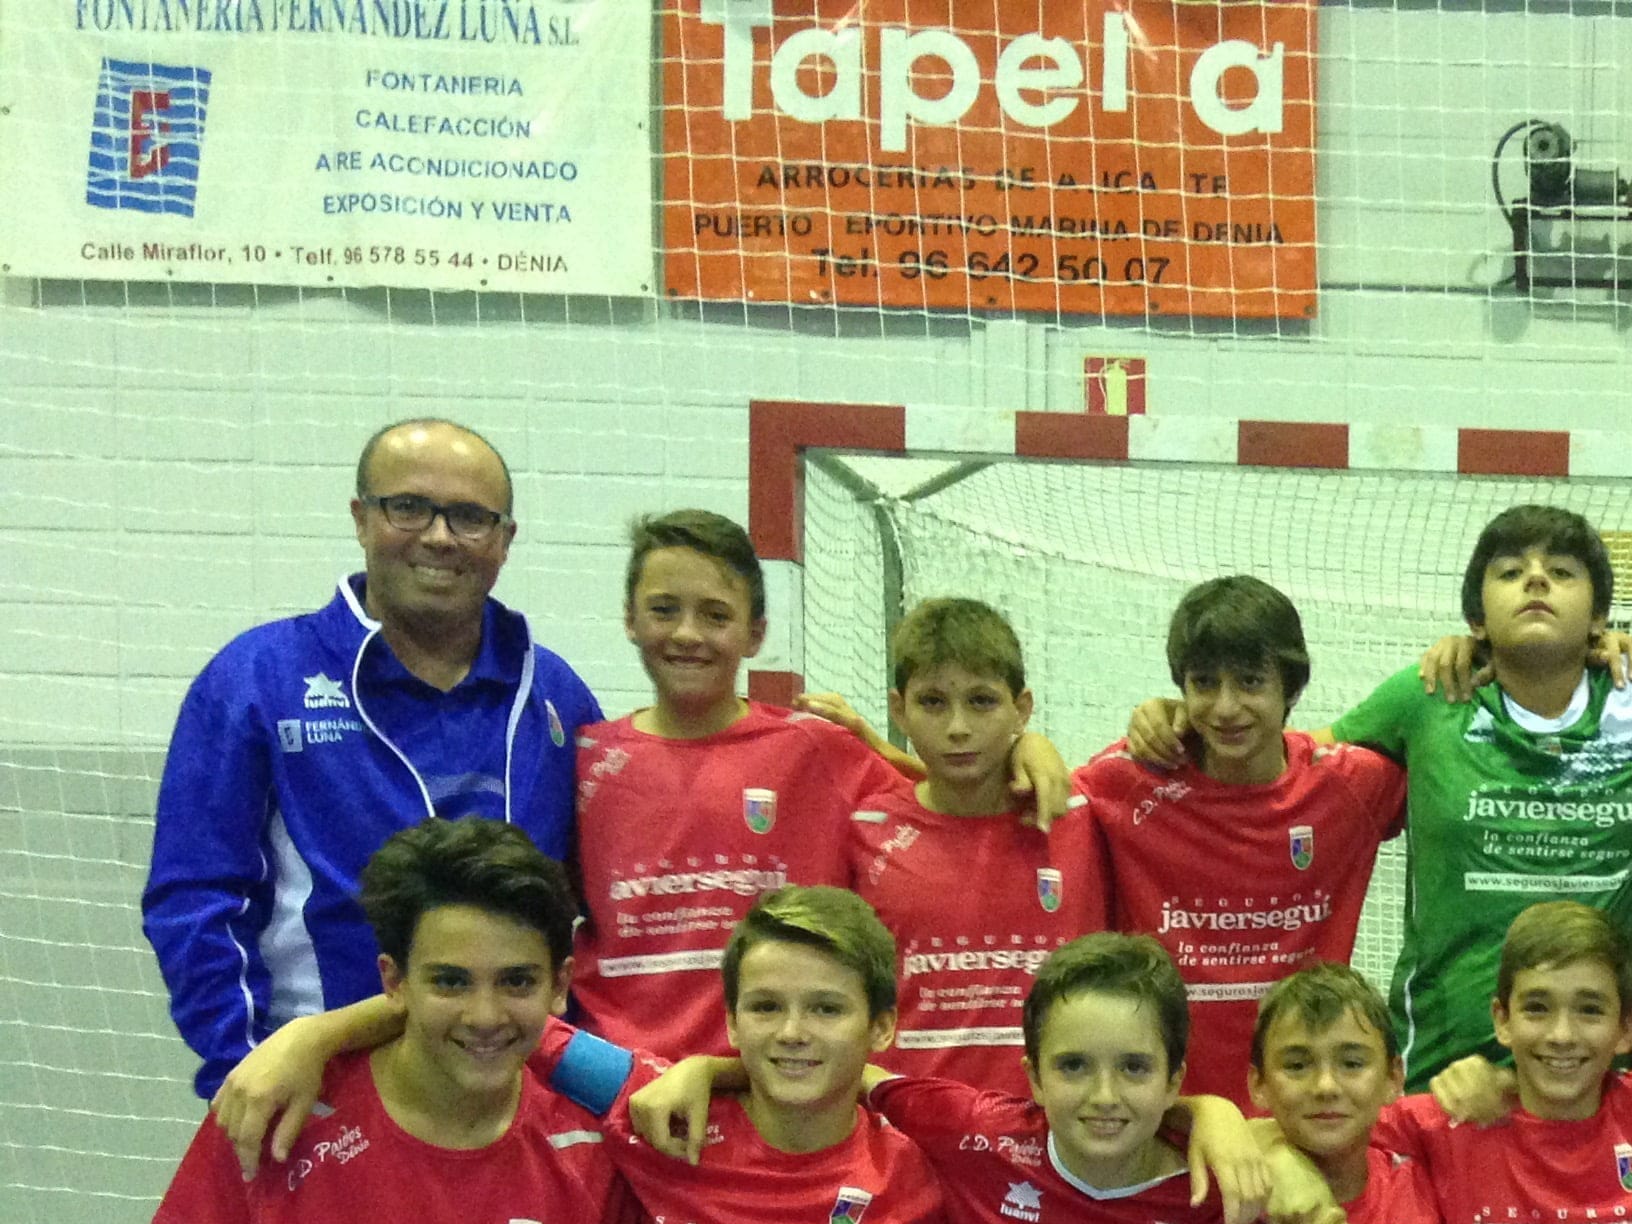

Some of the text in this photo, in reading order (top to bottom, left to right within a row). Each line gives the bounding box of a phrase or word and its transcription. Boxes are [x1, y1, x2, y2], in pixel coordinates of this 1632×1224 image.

[355, 109, 531, 138] CALEFACCIÓN
[370, 153, 578, 181] ACONDICIONADO
[323, 193, 572, 223] EXPOSICIÓN Y VENTA
[695, 214, 813, 238] PUERTO
[1010, 214, 1130, 243] MARINA
[81, 243, 135, 260] Calle
[242, 244, 267, 262] 10
[344, 247, 363, 265] 96
[370, 247, 406, 264] 578
[414, 249, 441, 266] 55
[448, 252, 475, 268] 44
[498, 252, 569, 272] DÉNIA
[900, 251, 949, 281] 96
[967, 252, 1039, 283] 642
[1055, 254, 1108, 285] 50
[1124, 257, 1172, 286] 07
[1483, 830, 1589, 847] la confianza
[1483, 843, 1502, 855] de
[1508, 844, 1575, 858] sentirse
[1178, 941, 1279, 957] la confianza
[1178, 954, 1197, 966] de
[1202, 953, 1266, 966] sentirse
[1000, 1203, 1040, 1223] luanvi
